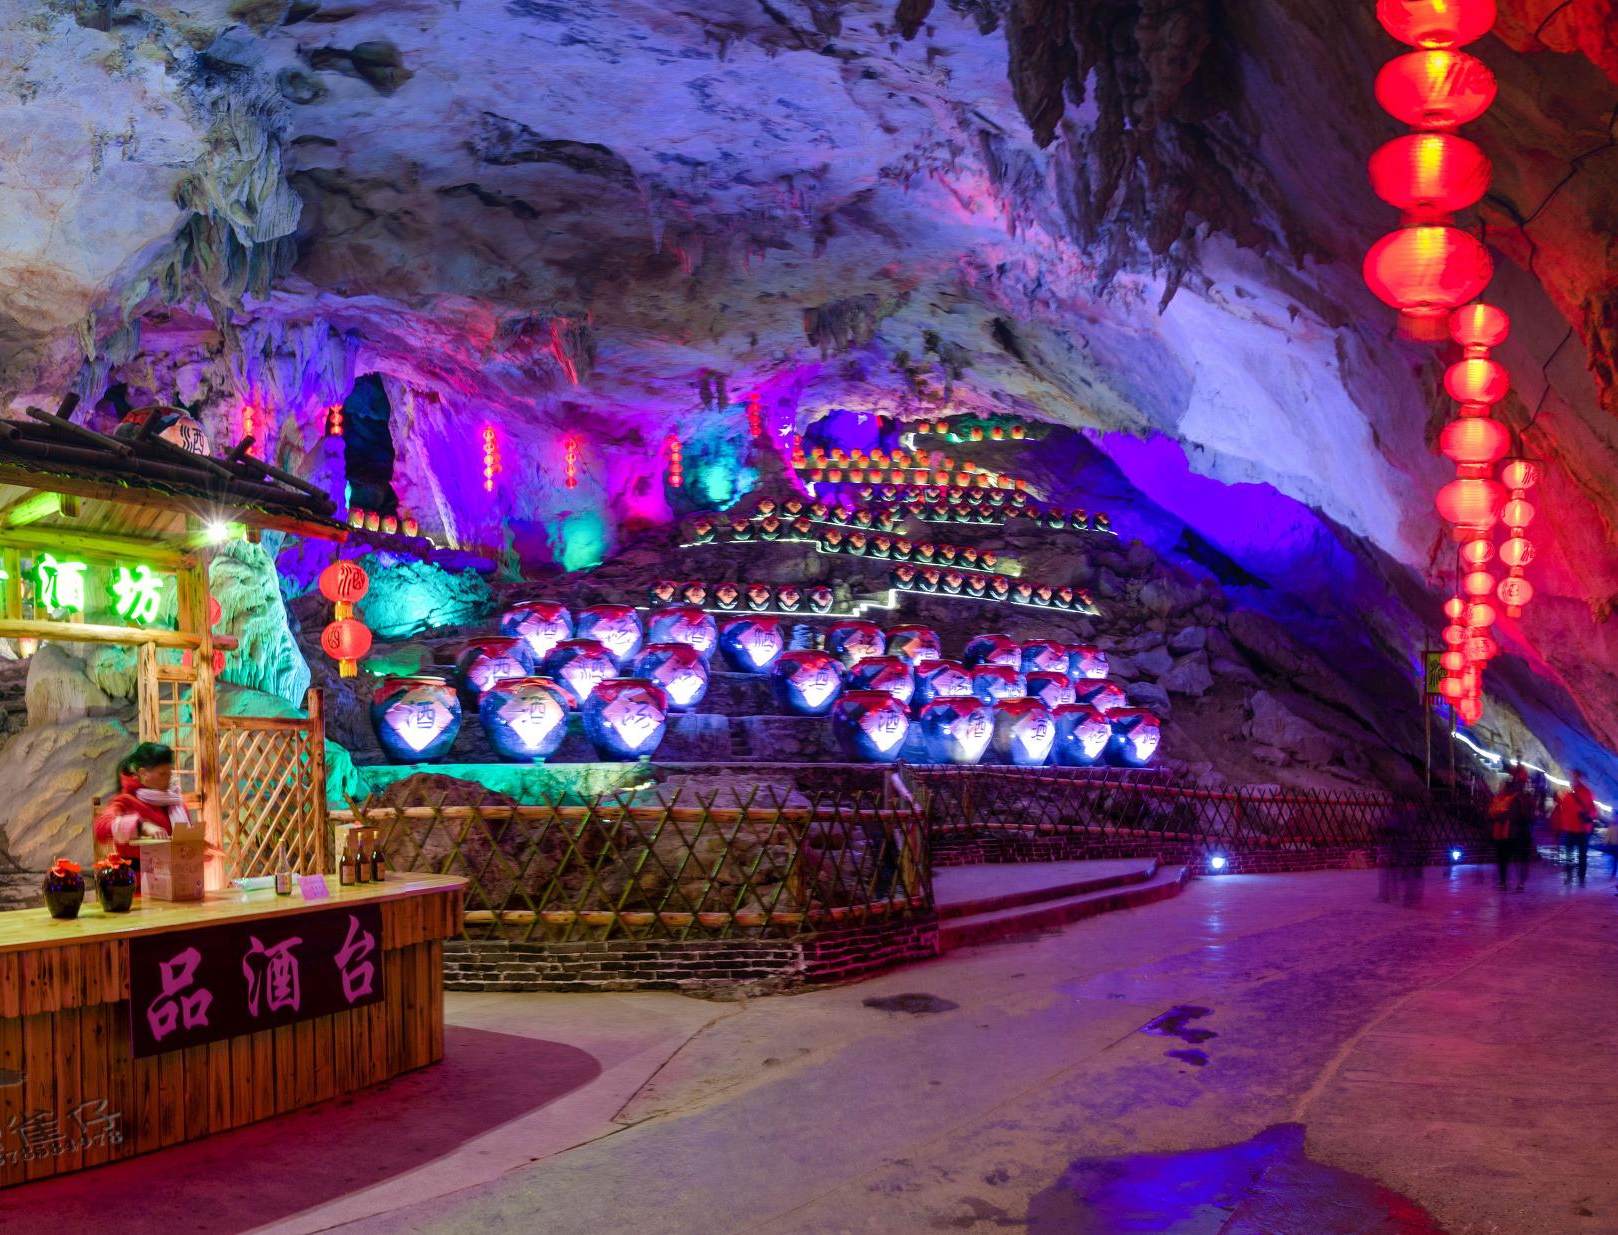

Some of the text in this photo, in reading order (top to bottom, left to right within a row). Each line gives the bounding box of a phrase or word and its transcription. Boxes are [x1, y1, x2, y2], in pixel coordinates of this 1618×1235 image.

[407, 701, 436, 729] 酒
[147, 914, 375, 1041] 品酒台
